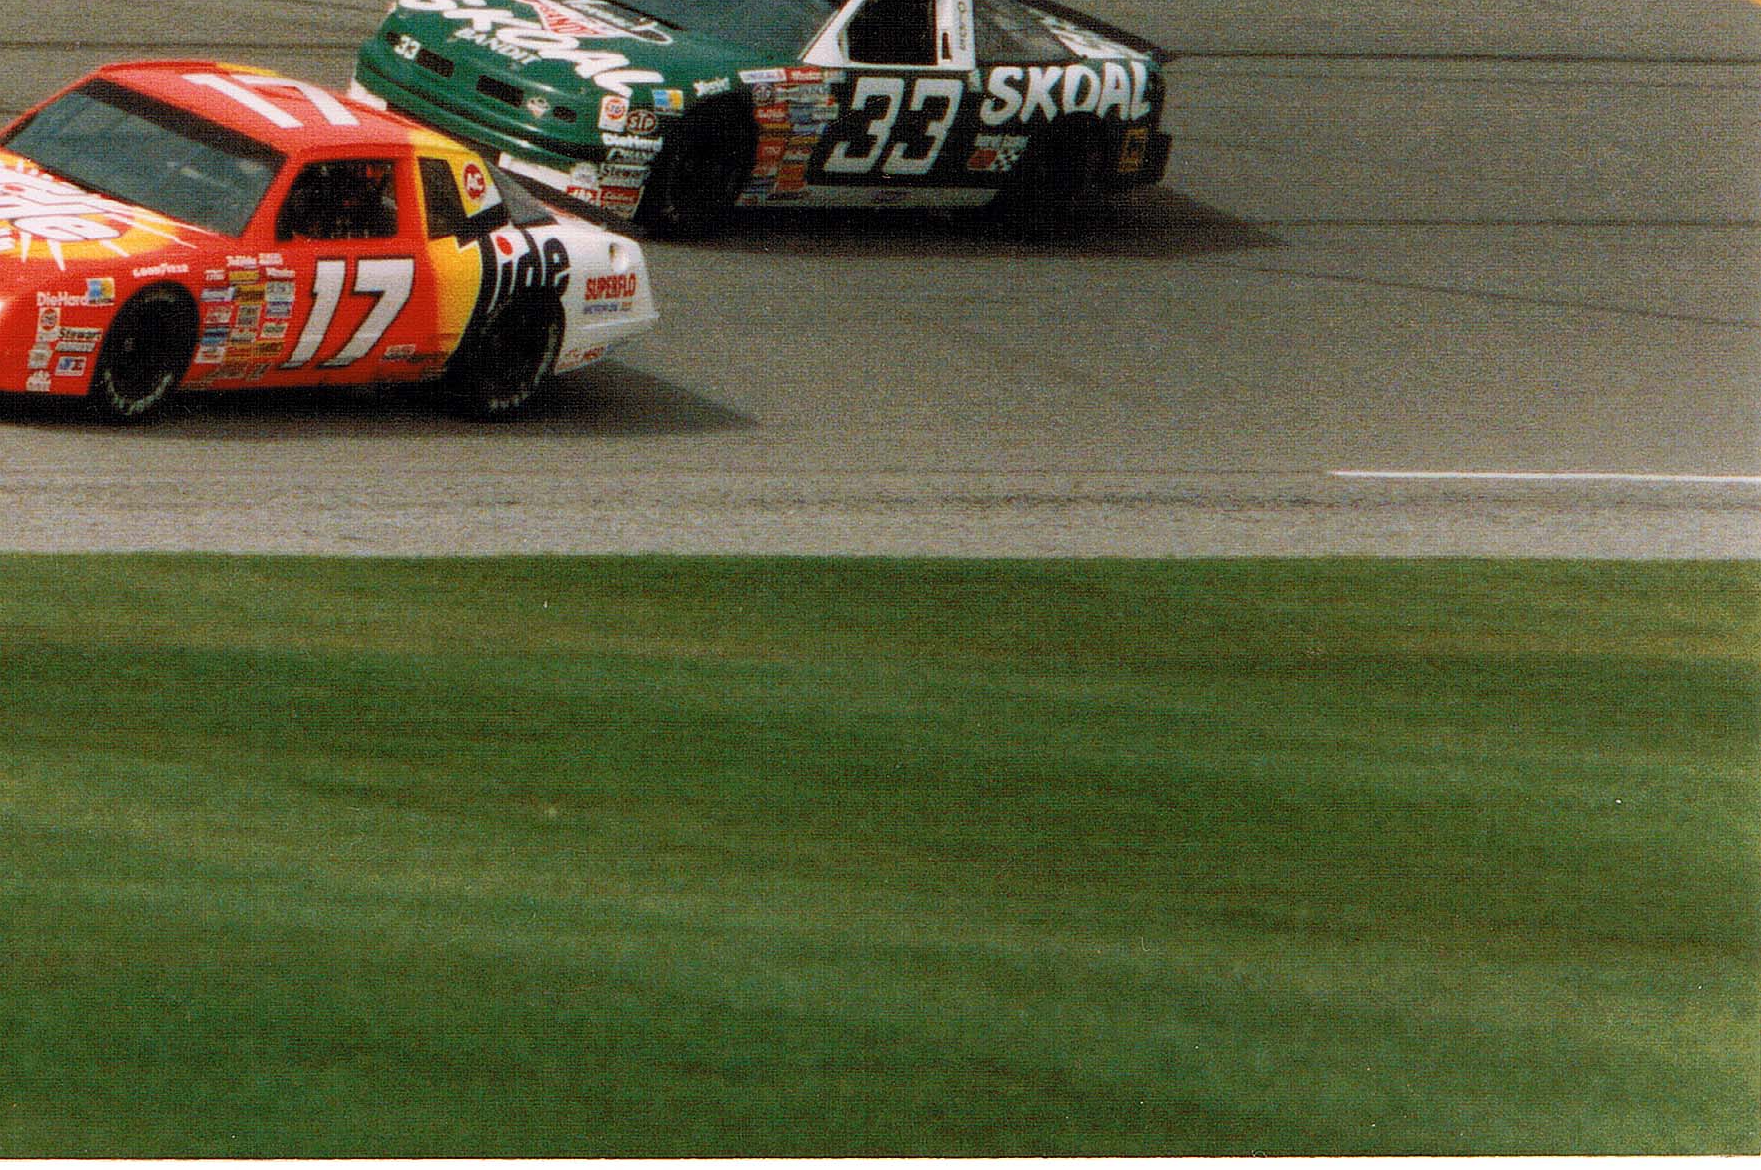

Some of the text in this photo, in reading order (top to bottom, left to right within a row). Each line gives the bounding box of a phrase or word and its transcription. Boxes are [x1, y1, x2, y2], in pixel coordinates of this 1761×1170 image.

[393, 33, 422, 61] 33
[181, 72, 360, 129] 17
[979, 61, 1154, 126] SKOAL
[823, 76, 964, 175] 33
[277, 259, 416, 369] 17
[583, 273, 637, 301] SUPERFLO
